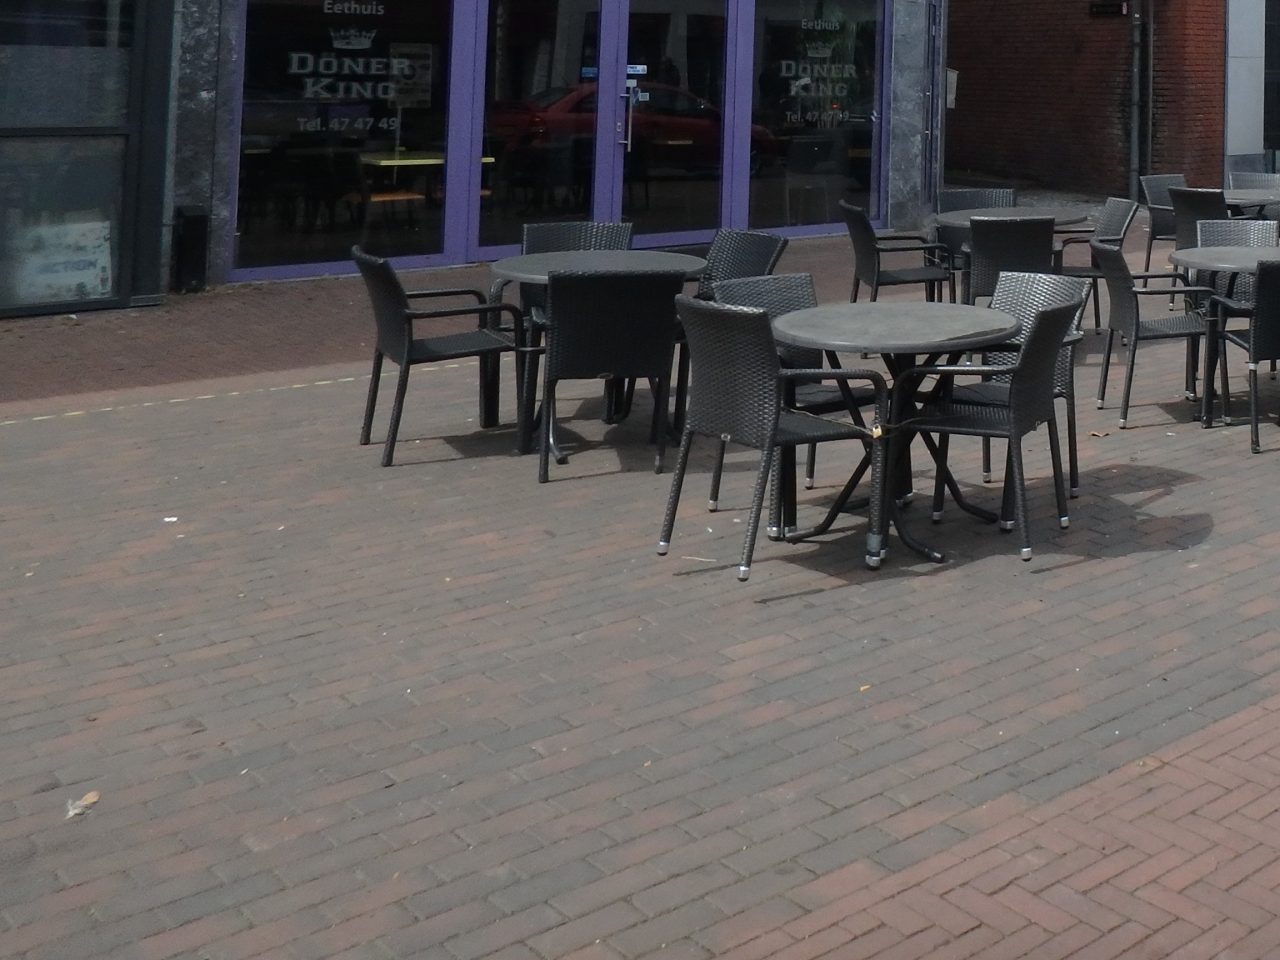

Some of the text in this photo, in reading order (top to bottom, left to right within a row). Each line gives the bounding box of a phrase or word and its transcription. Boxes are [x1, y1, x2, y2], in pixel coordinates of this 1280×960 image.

[323, 0, 385, 16] Eethuis
[801, 18, 841, 31] Eethuis
[297, 116, 400, 132] Tel. 47 47 49
